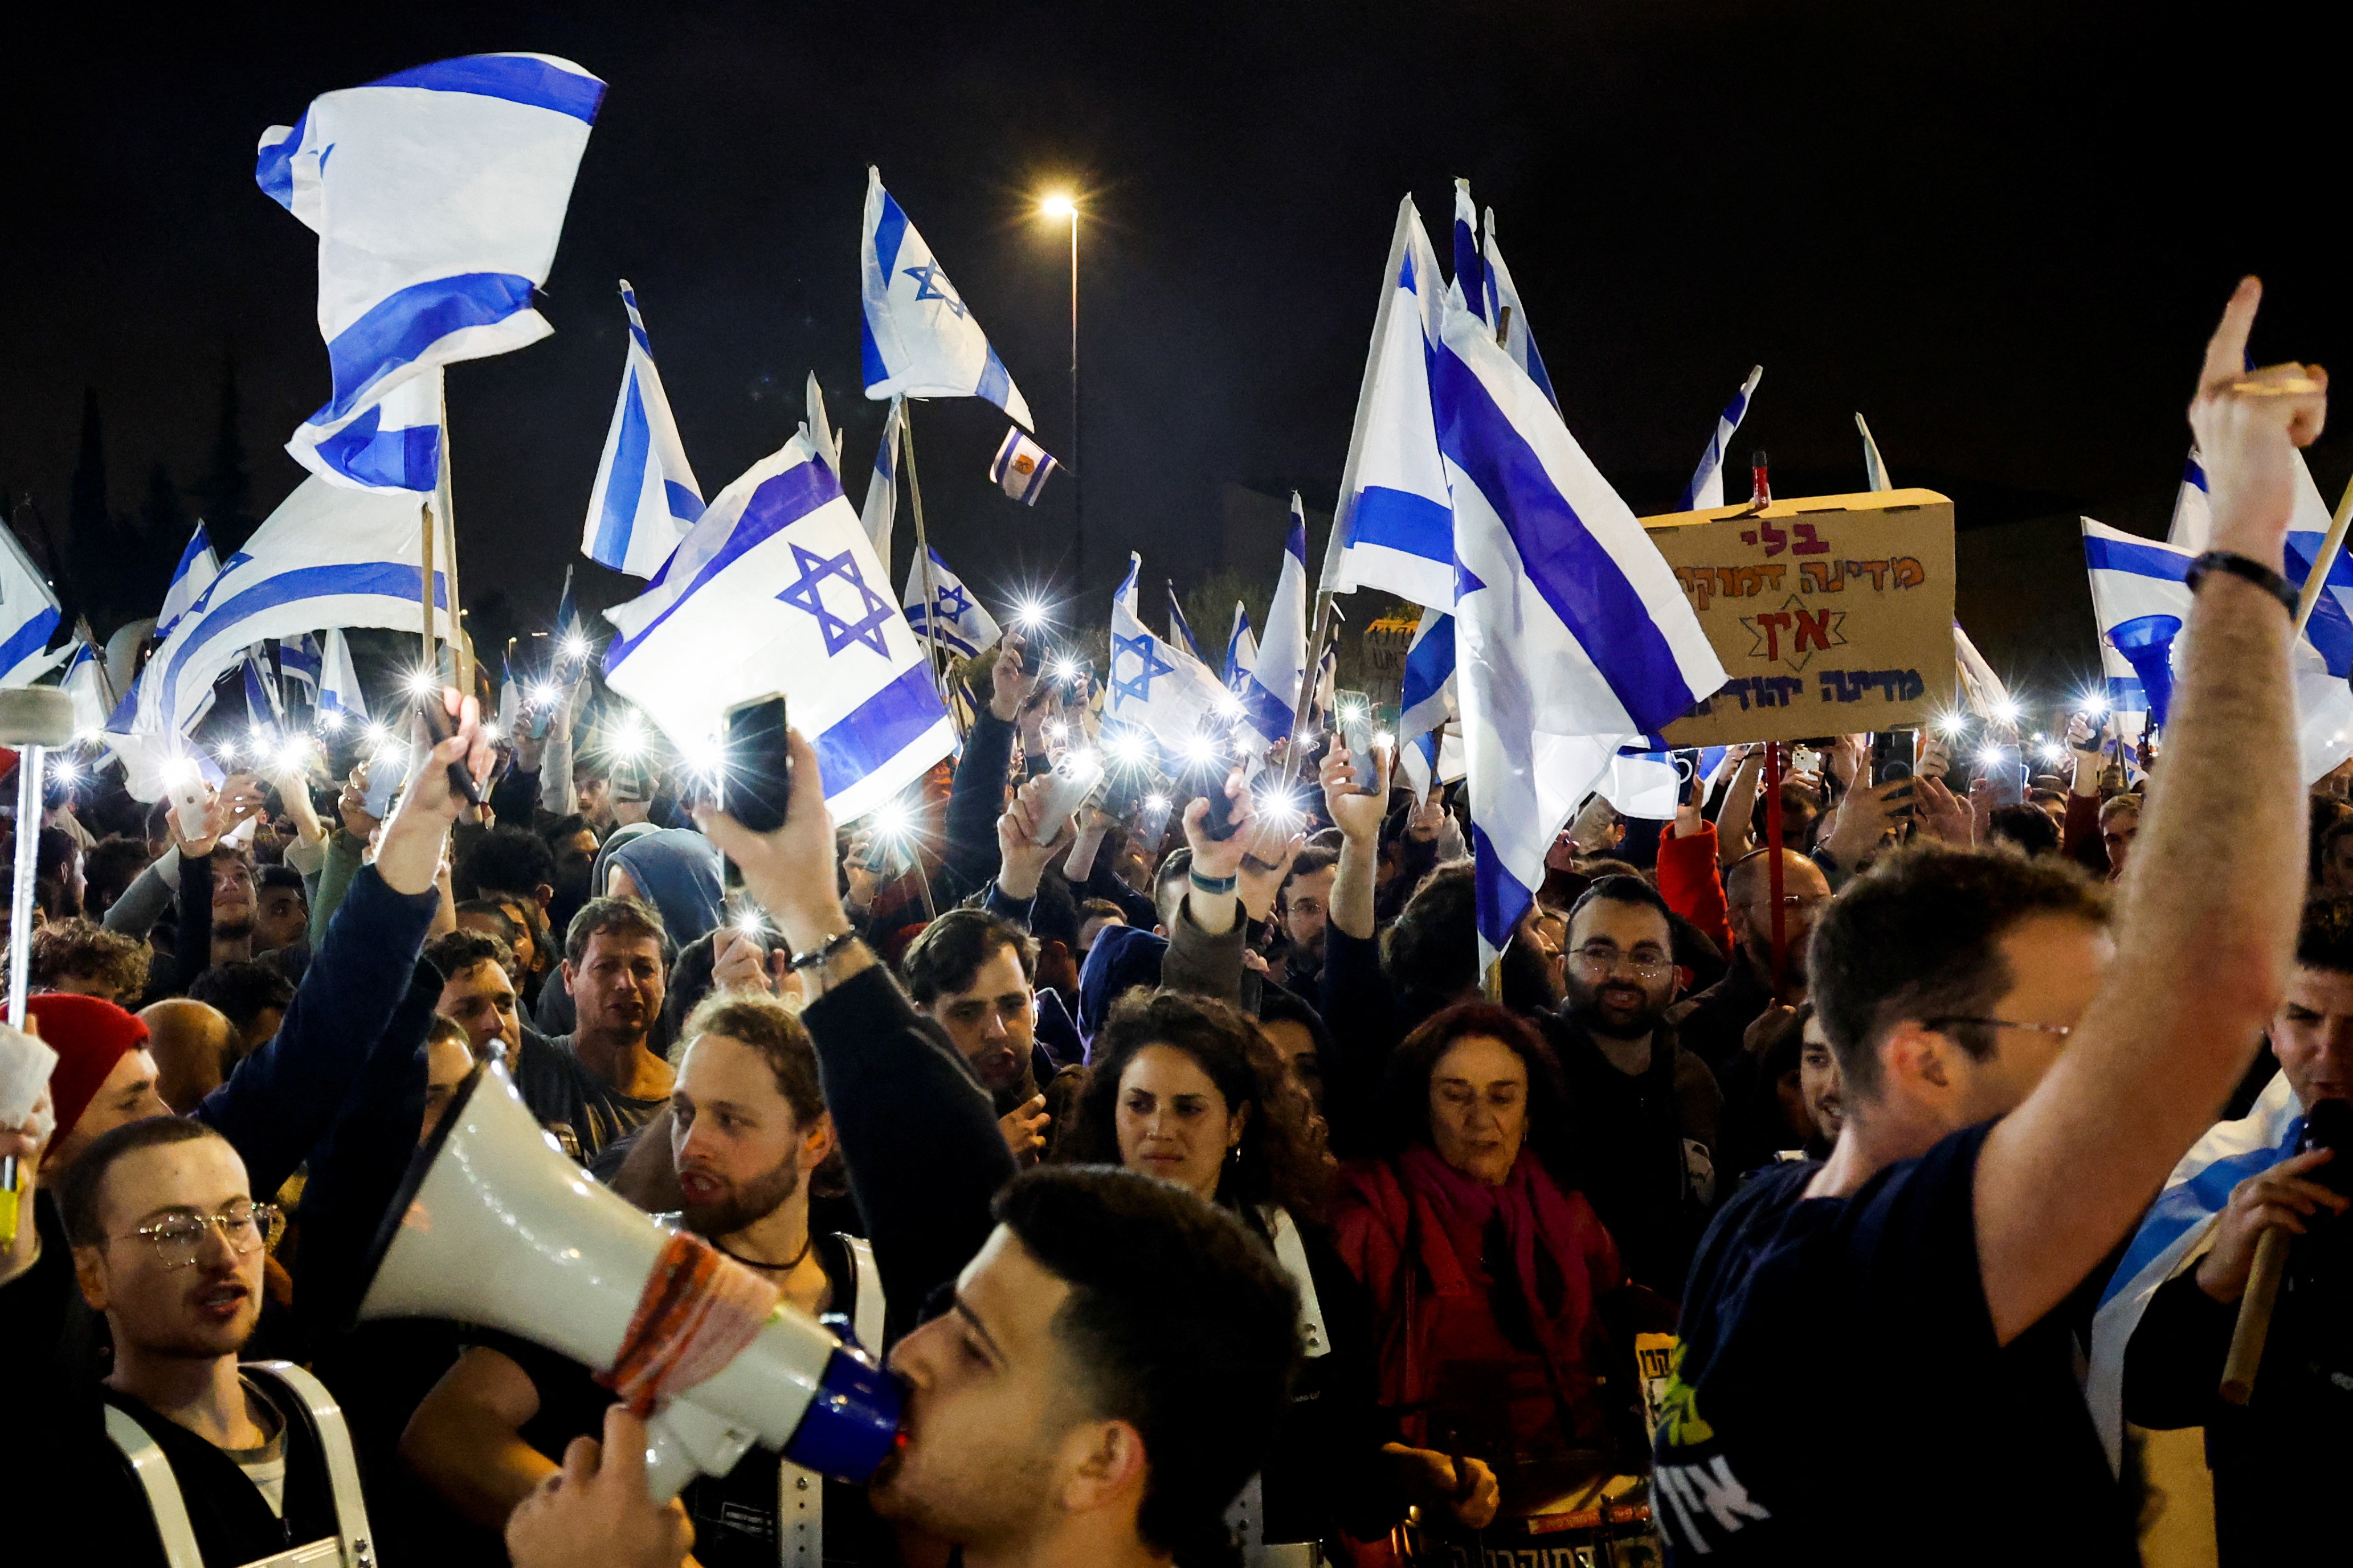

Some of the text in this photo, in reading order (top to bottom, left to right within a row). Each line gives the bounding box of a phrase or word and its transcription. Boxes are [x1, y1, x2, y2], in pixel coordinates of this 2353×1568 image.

[1741, 521, 1830, 557] בלי
[1800, 556, 1925, 594] מדינה
[1757, 608, 1831, 661] אין
[1682, 668, 1925, 718] מדינה יהוד
